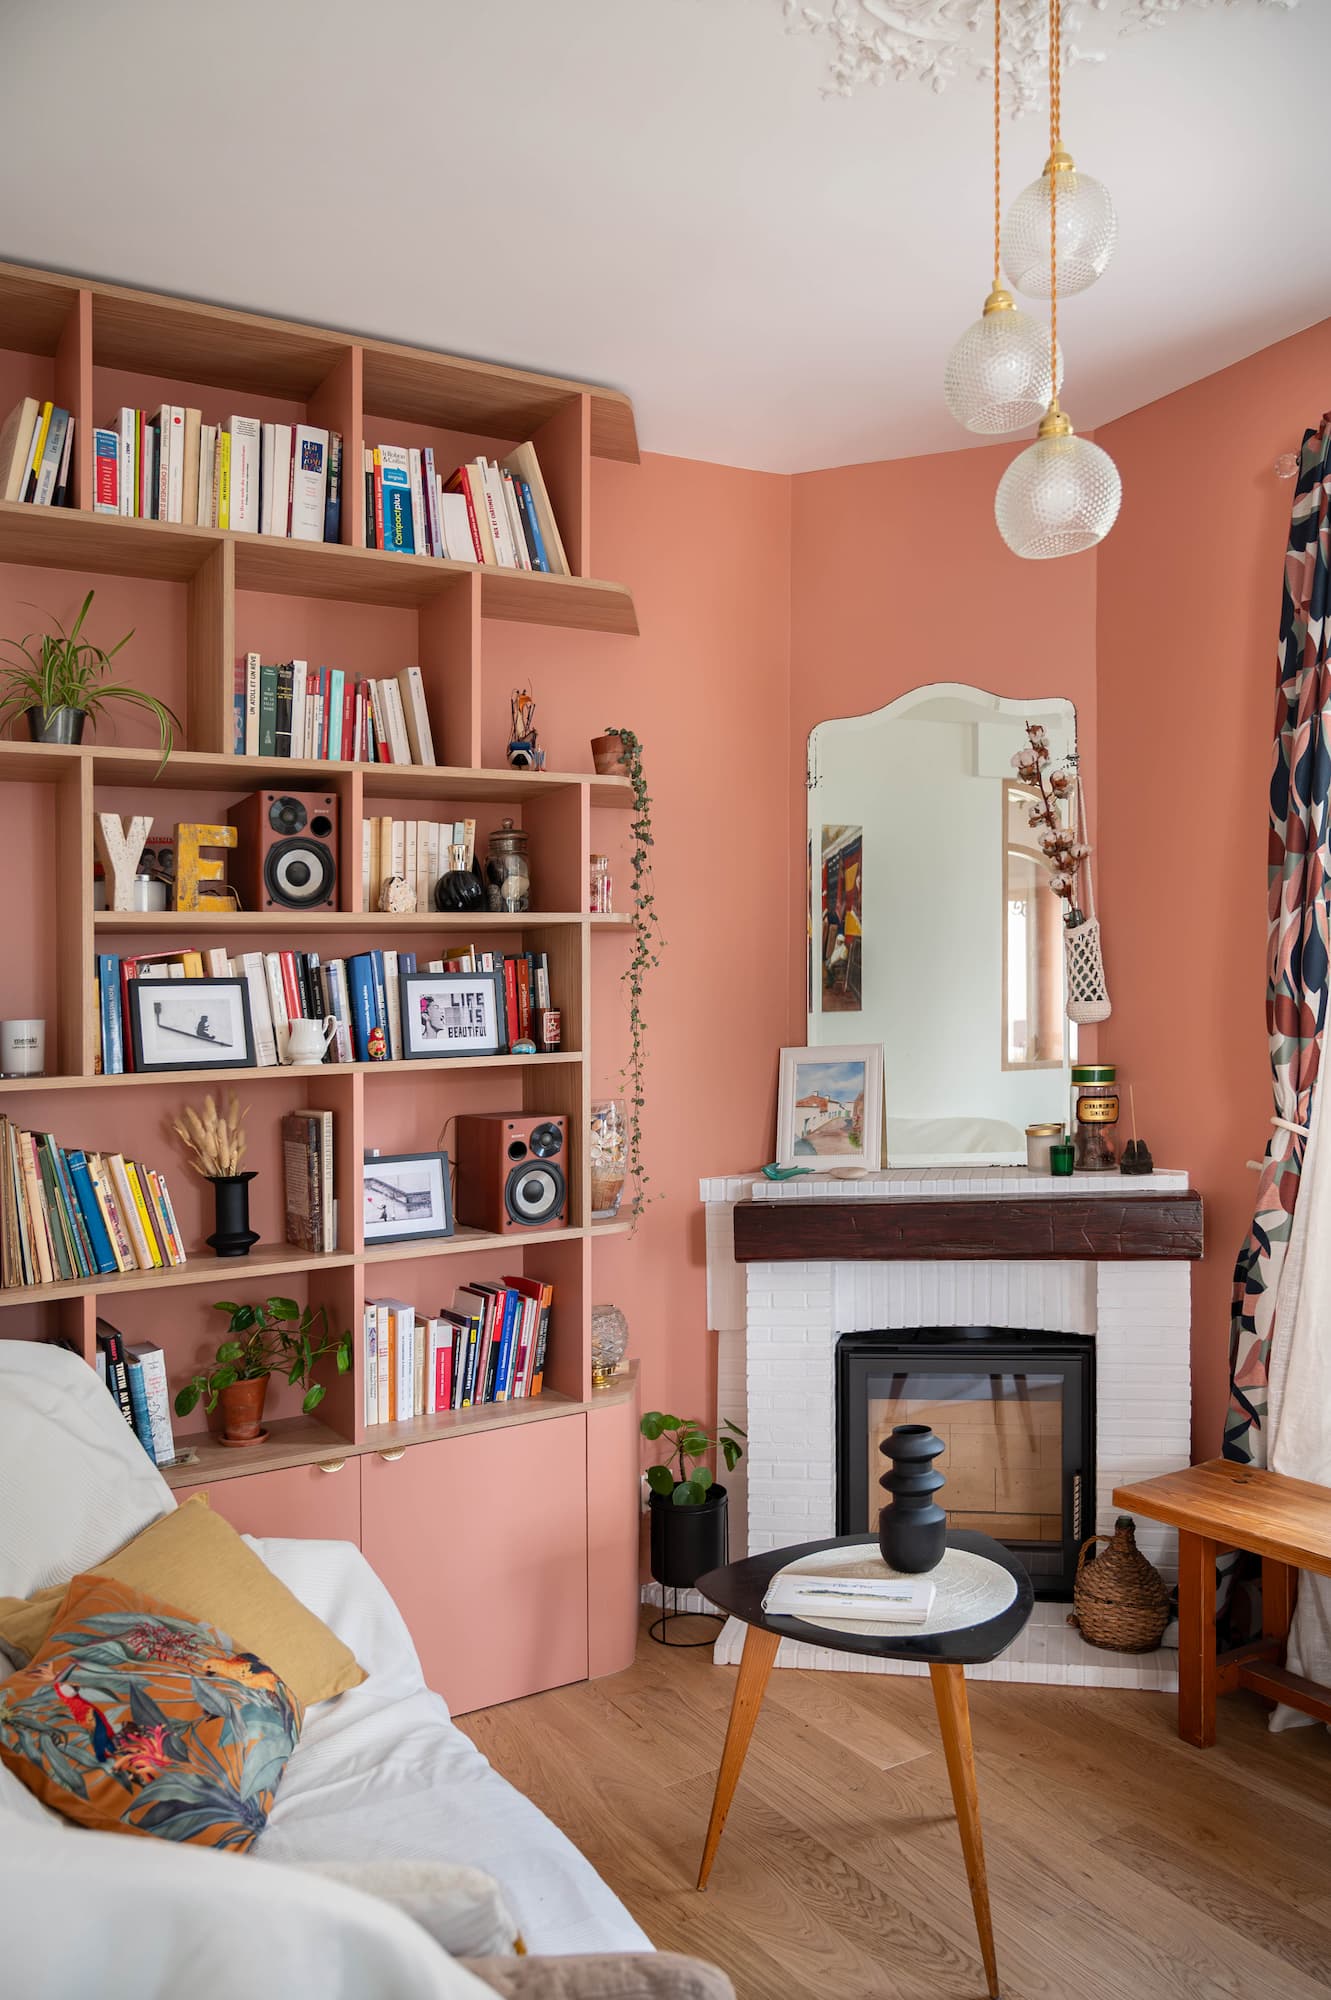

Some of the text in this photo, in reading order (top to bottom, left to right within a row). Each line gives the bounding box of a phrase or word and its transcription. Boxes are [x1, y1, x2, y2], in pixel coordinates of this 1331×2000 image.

[96, 812, 154, 911] Y
[450, 992, 485, 1007] LIFE
[469, 1009, 483, 1023] IS
[447, 1026, 487, 1039] BEAUTIFUL
[115, 1361, 127, 1390] TINTIN
[119, 1391, 129, 1404] AU
